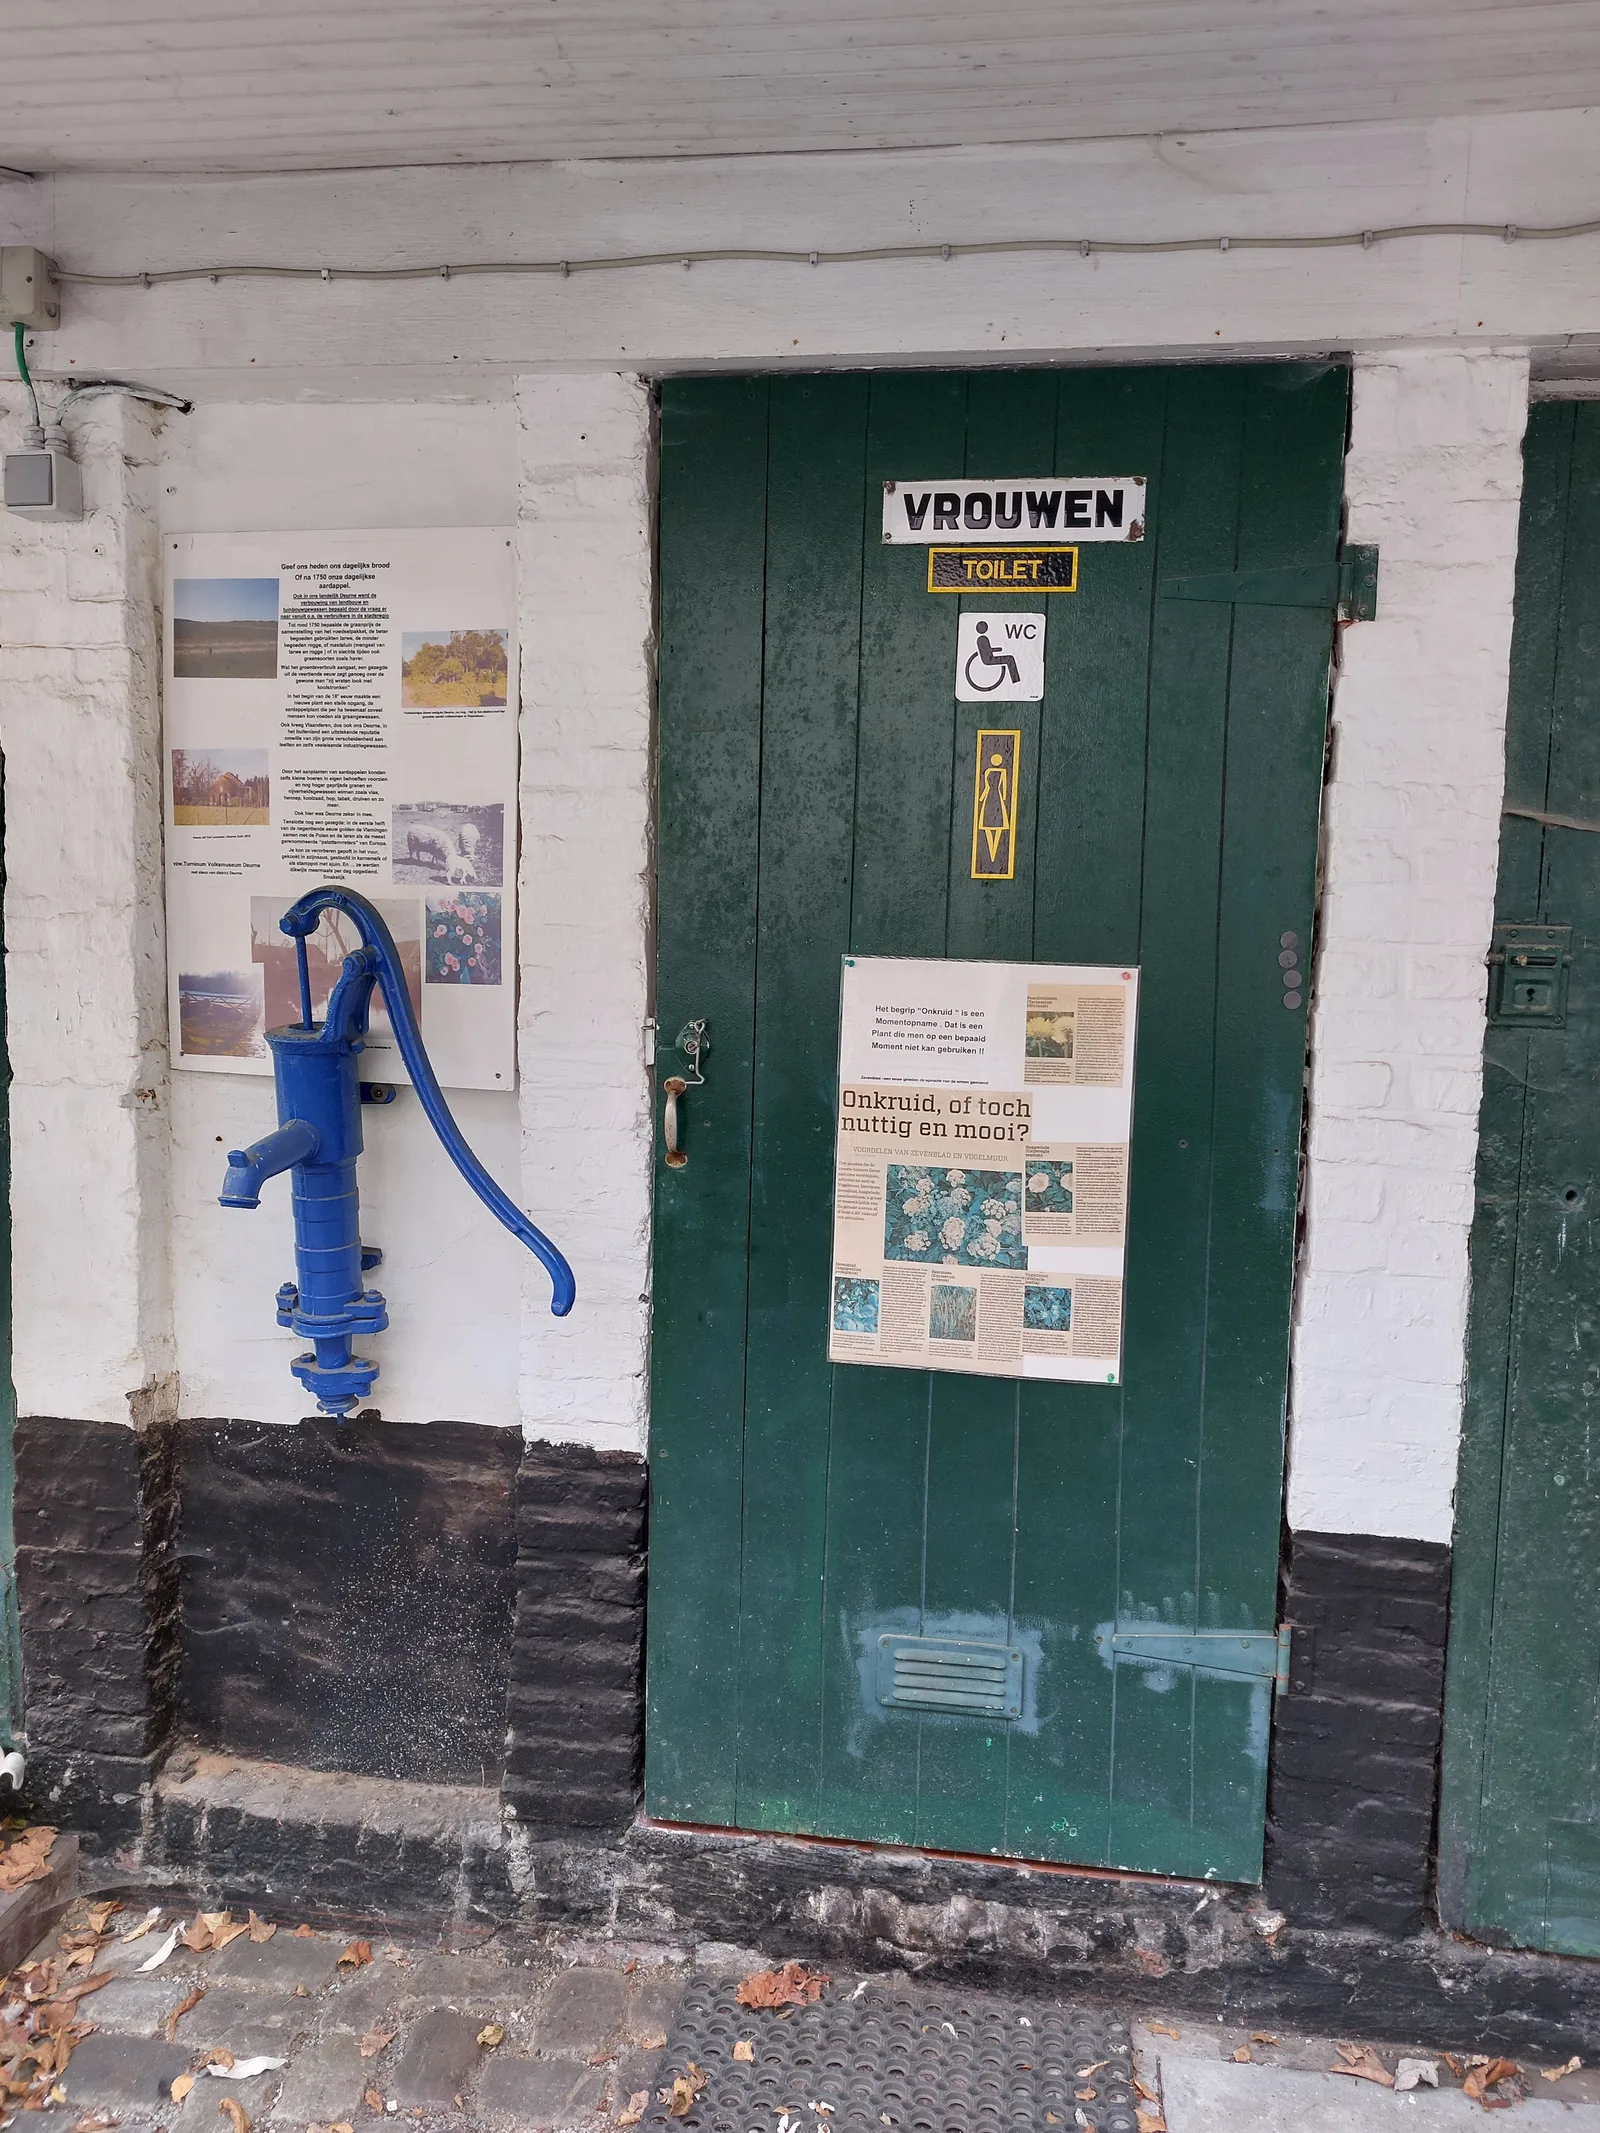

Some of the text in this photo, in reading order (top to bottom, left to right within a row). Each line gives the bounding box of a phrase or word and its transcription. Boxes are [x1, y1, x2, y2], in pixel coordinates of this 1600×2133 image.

[903, 489, 1124, 531] VROUWEN
[962, 559, 1043, 580] TOILET
[1004, 624, 1037, 640] WC
[891, 1006, 915, 1016] begrip
[961, 1009, 968, 1017] is
[876, 1018, 938, 1029] Momentopname
[944, 1021, 958, 1029] Dat
[872, 1030, 891, 1038] Plant
[893, 1031, 905, 1039] die
[955, 1034, 986, 1043] bepaald
[872, 1043, 903, 1051] Moment
[905, 1044, 919, 1052] niet
[937, 1045, 976, 1055] gebruiken
[979, 1047, 984, 1055] !!
[843, 1090, 1032, 1118] Onkruid, of toch
[841, 1115, 1029, 1142] nuttig en mooi?
[853, 1147, 893, 1155] VOORDELEN
[910, 1150, 952, 1158] ZEVENBLAD
[964, 1153, 1008, 1162] VOGELMUUR
